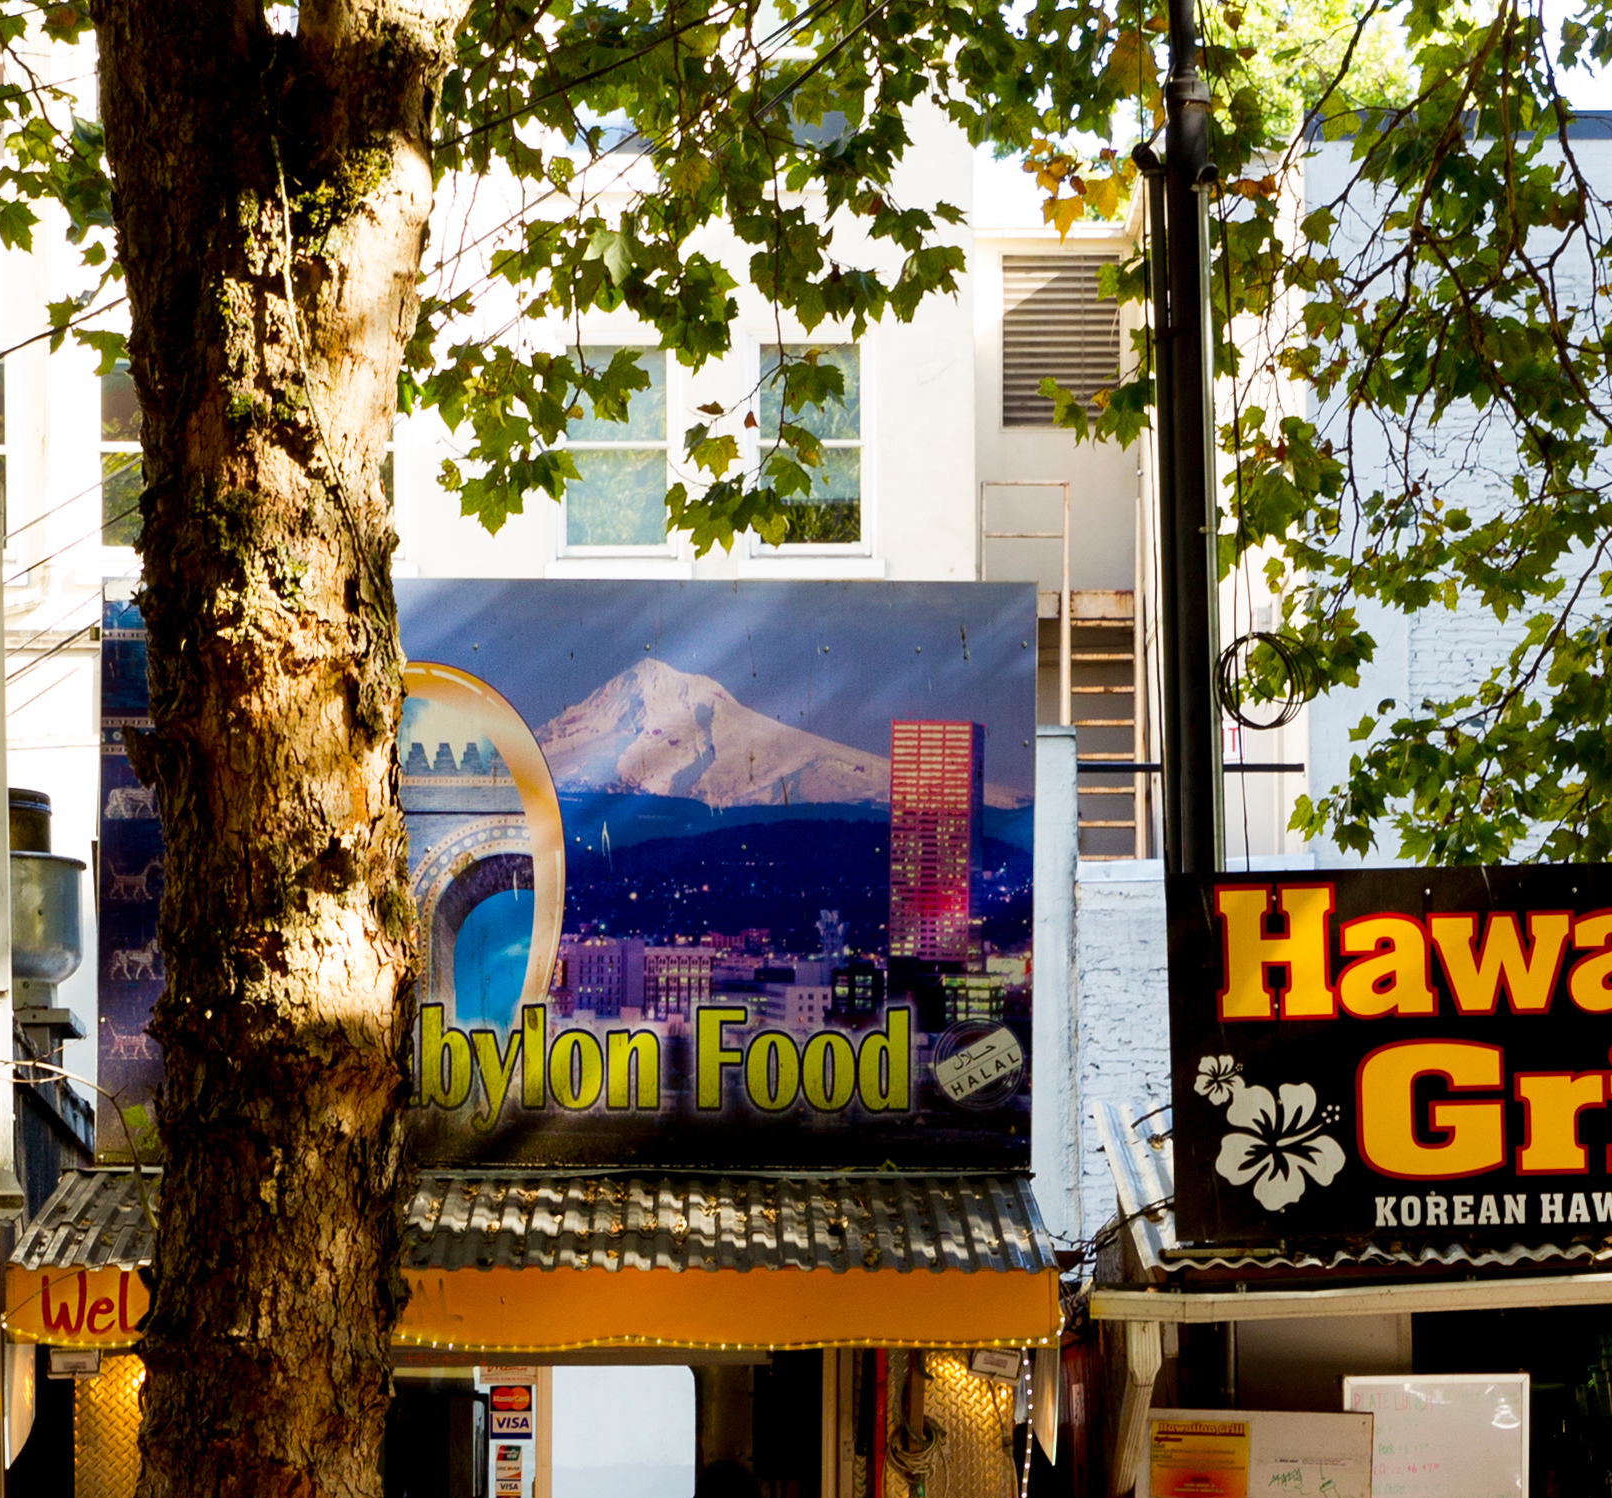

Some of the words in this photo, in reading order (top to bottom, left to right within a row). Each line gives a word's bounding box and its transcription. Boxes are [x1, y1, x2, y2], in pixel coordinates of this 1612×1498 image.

[407, 1003, 660, 1131] bylon
[696, 1006, 911, 1112] Food
[950, 1052, 1019, 1097] HALAL
[1375, 1195, 1528, 1228] KOREAN
[496, 1417, 529, 1428] VISA
